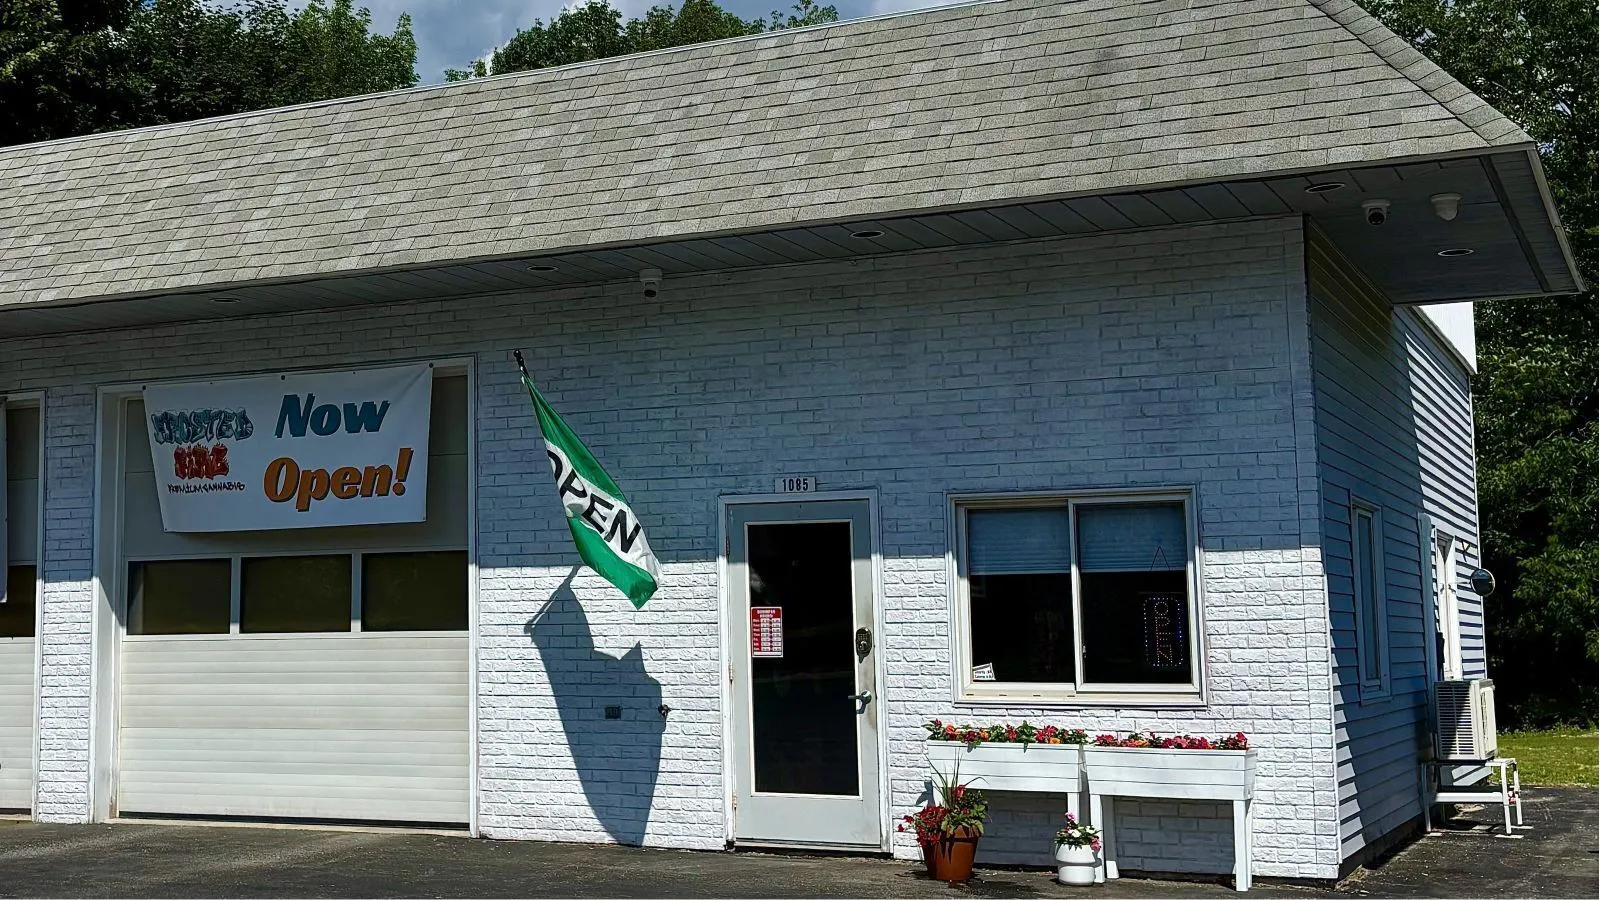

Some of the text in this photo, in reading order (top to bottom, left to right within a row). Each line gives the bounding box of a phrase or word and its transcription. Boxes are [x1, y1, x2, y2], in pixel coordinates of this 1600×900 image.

[275, 393, 391, 438] Now
[263, 448, 414, 512] Open!
[783, 478, 808, 491] 1085
[1154, 601, 1173, 664] OPEN
